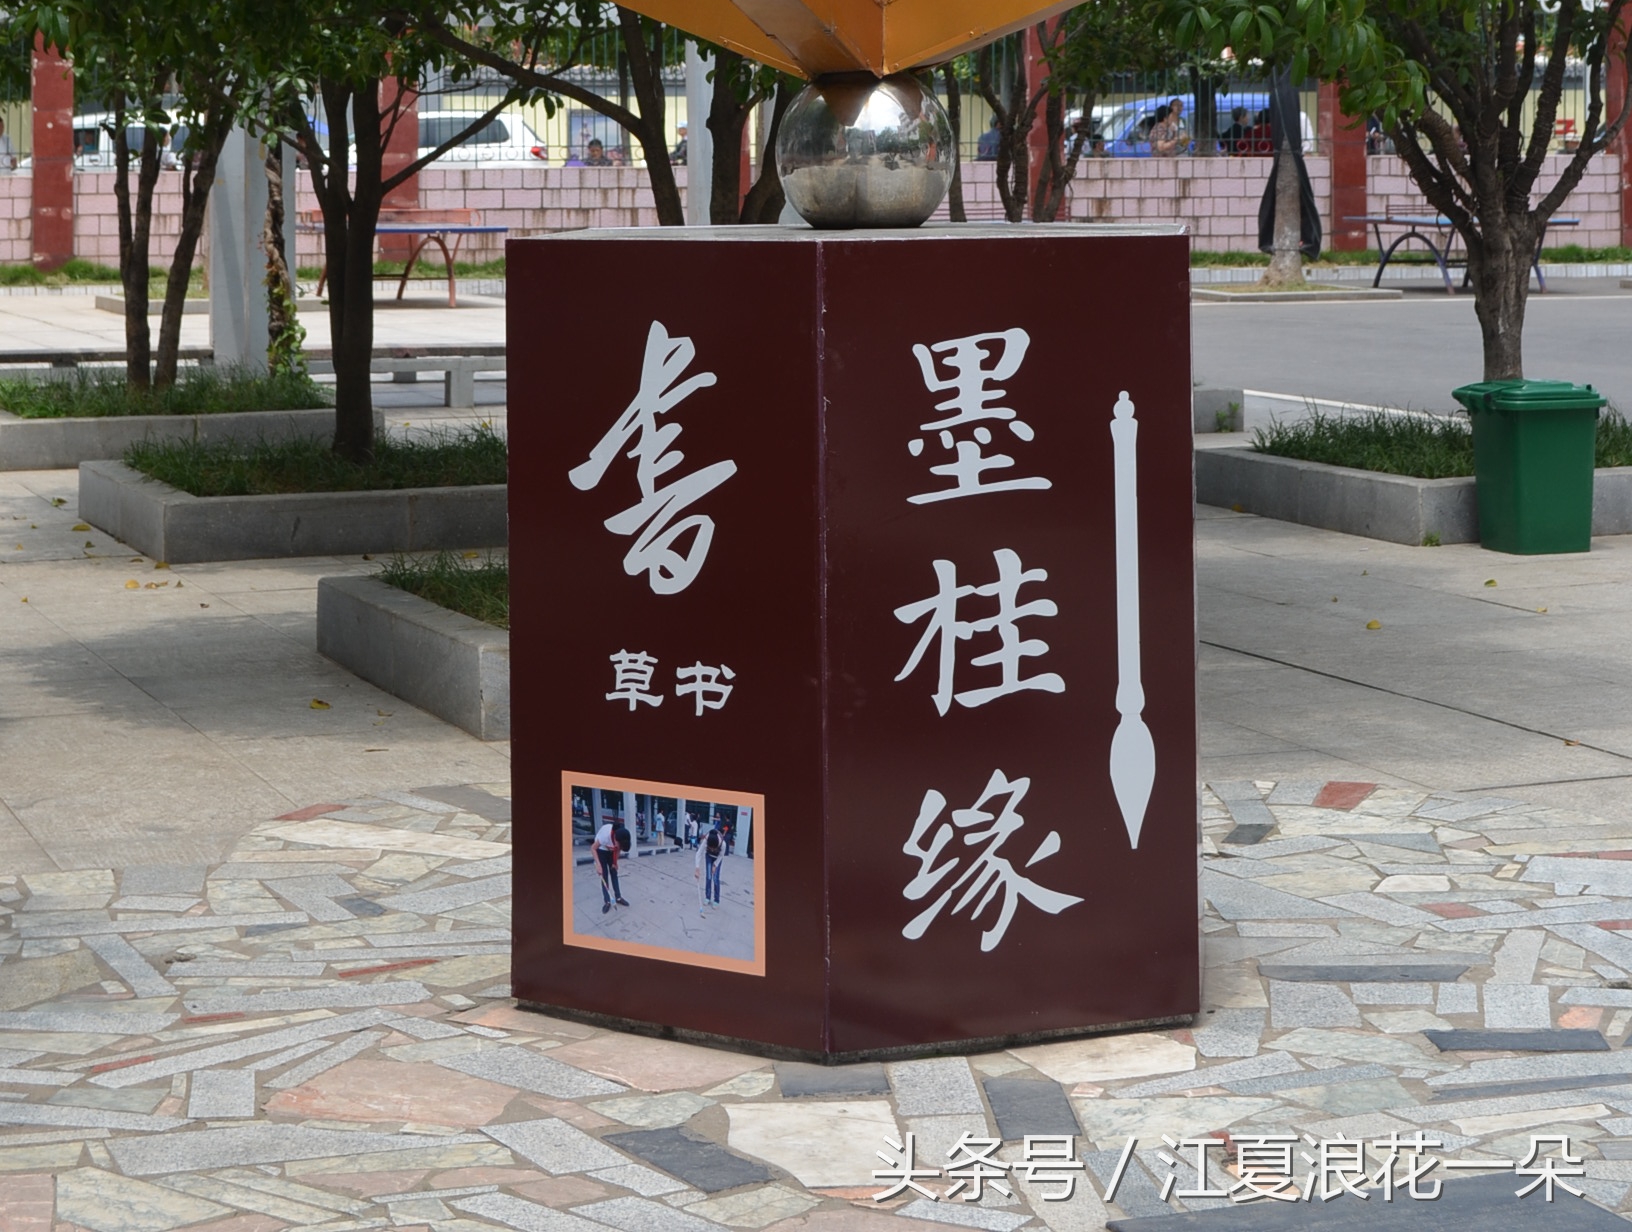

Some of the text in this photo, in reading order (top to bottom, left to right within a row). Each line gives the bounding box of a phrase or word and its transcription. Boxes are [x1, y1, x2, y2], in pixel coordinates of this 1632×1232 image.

[605, 648, 736, 717] 草书
[893, 327, 1085, 953] 墨桂缘
